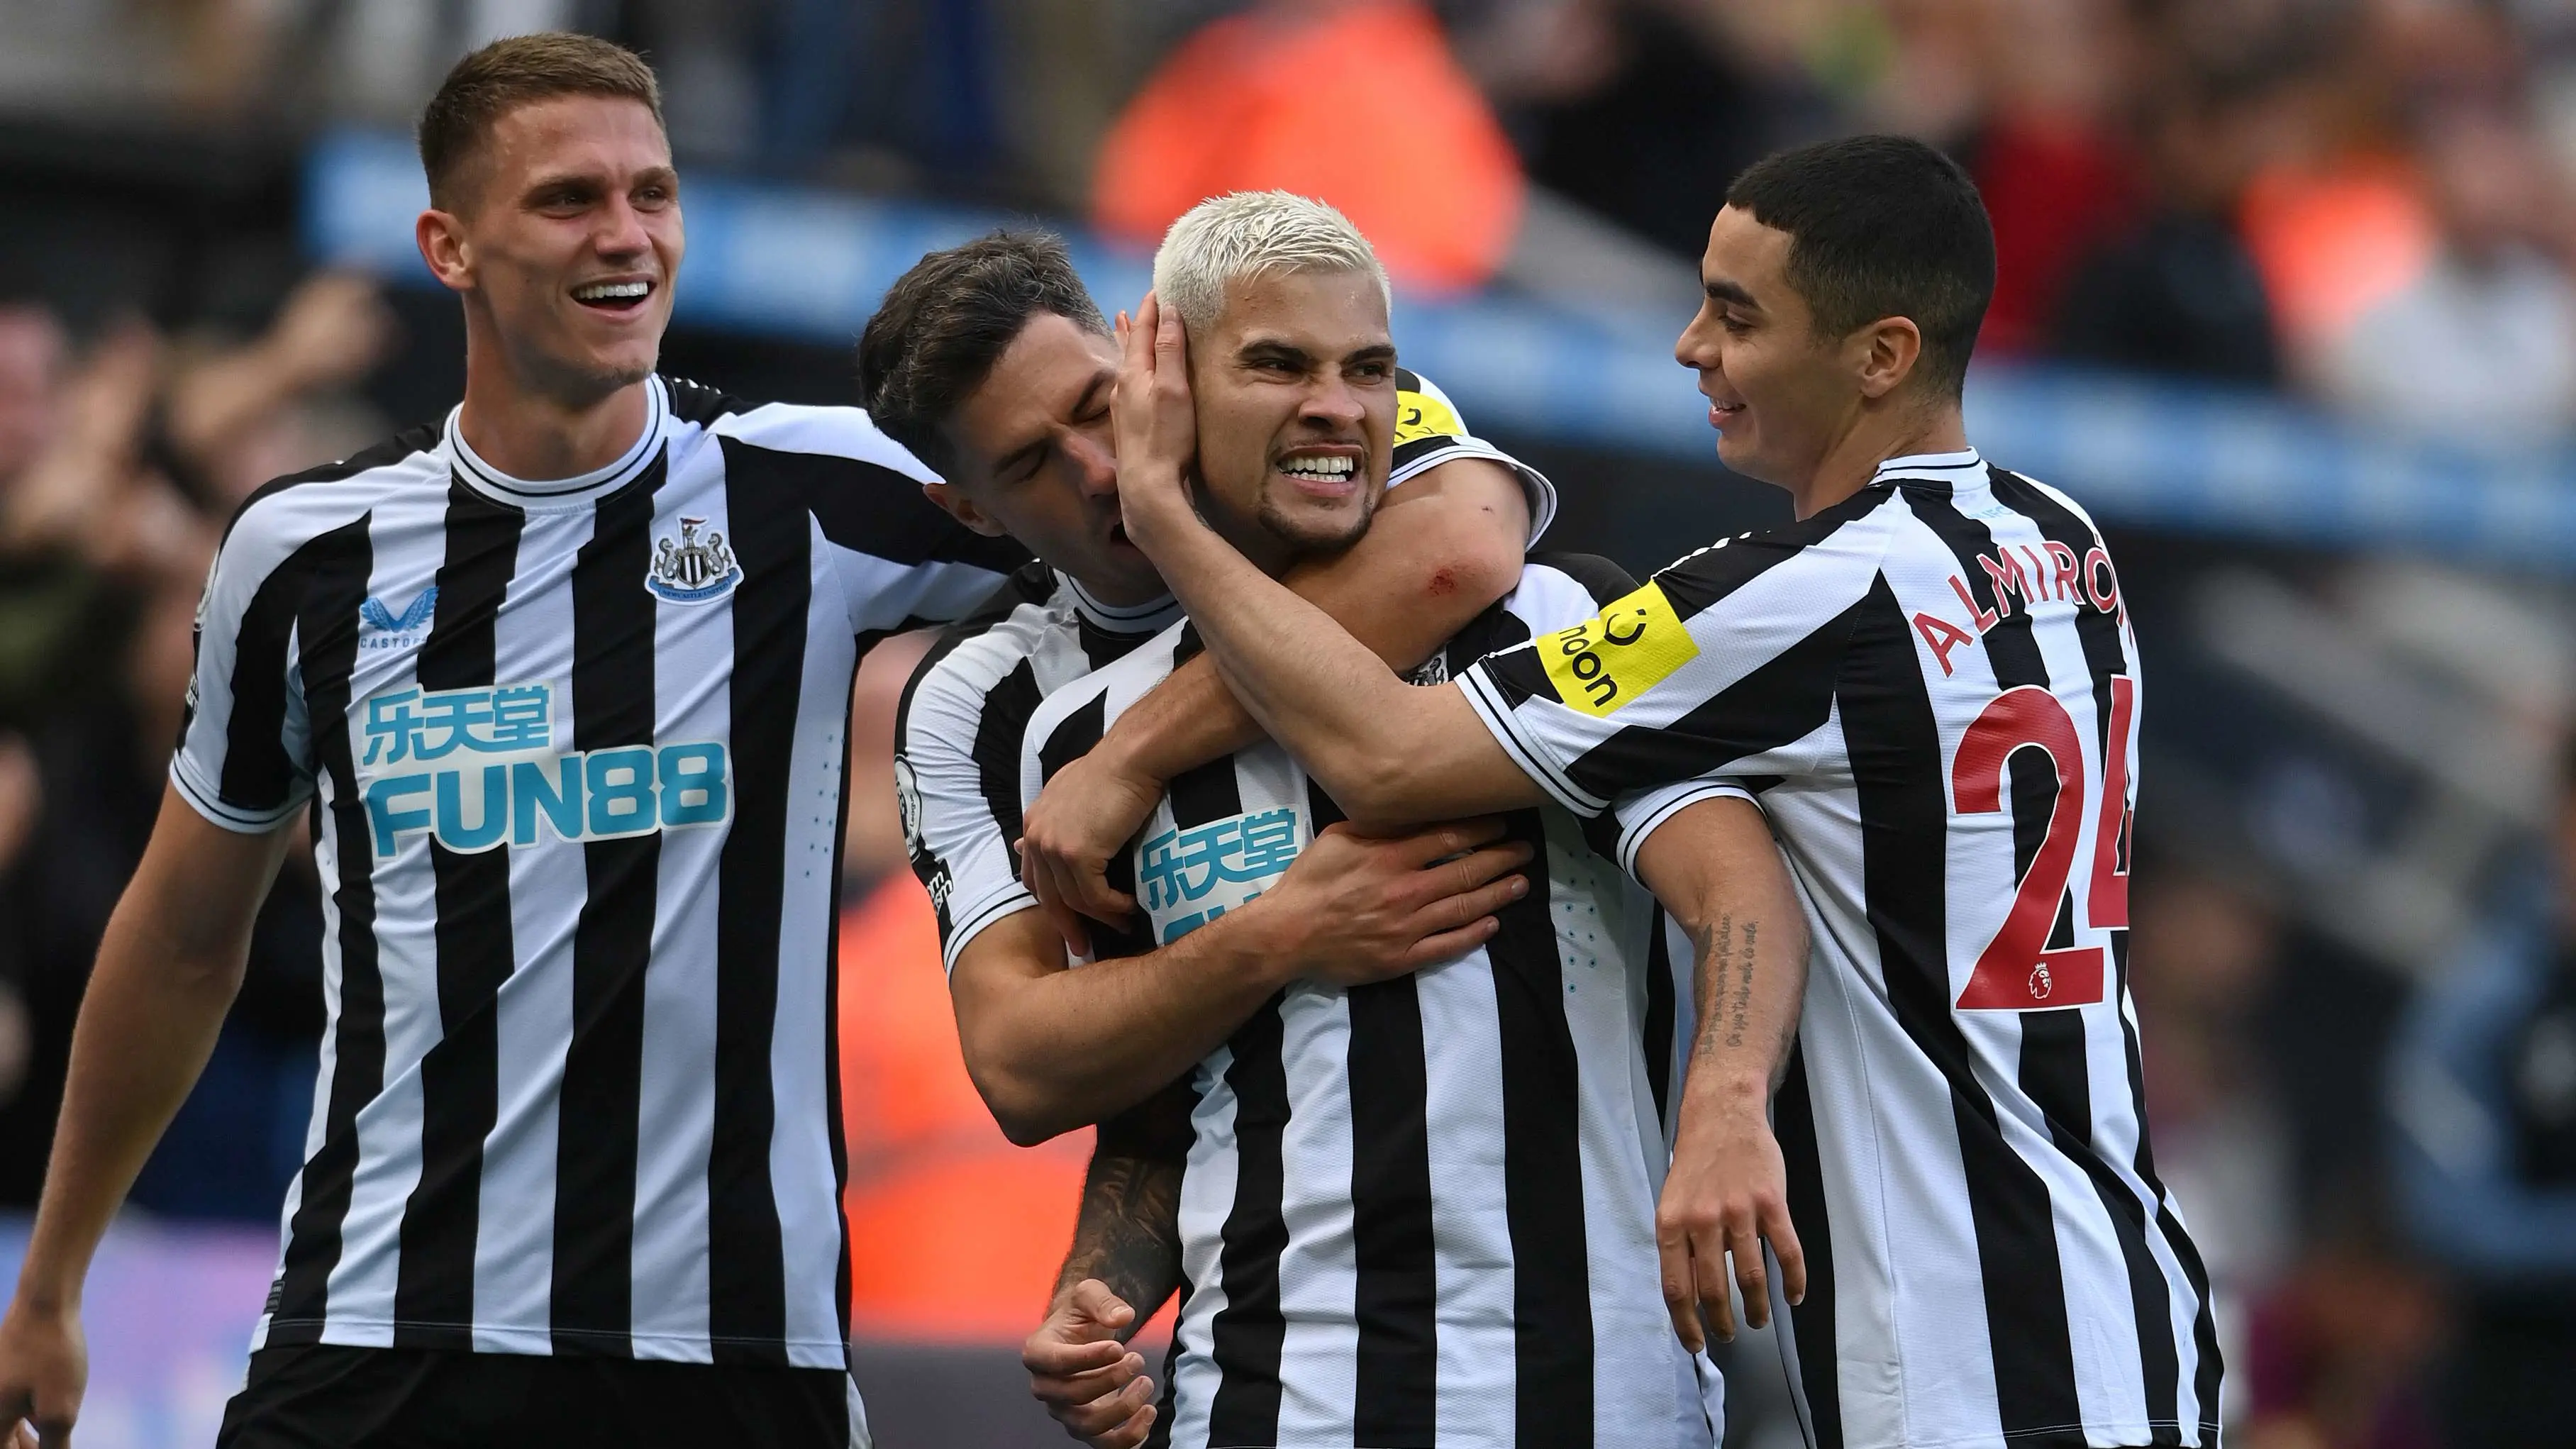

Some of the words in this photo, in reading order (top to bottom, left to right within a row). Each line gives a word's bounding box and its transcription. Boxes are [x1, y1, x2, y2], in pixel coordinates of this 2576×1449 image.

[1558, 623, 1619, 709] noon
[362, 684, 550, 766] 乐天堂
[366, 742, 727, 857] FUN88
[1140, 808, 1298, 911] 乐天堂
